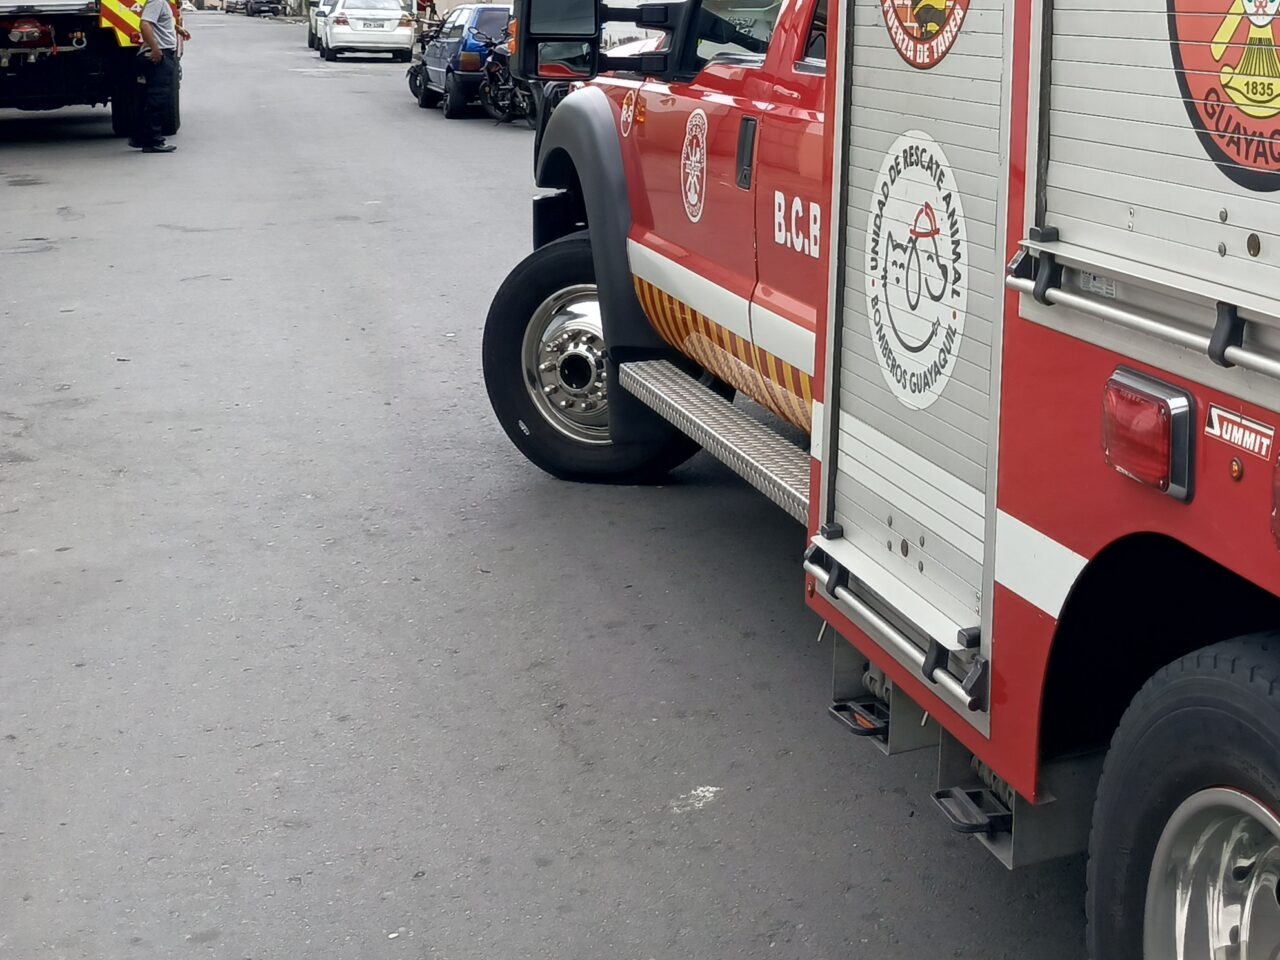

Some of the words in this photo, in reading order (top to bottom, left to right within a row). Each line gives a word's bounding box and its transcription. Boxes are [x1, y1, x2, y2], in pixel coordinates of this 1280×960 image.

[916, 43, 930, 63] DE
[931, 4, 964, 59] TAREA
[1244, 81, 1274, 97] 1835
[870, 181, 890, 271] UNIDAD
[888, 155, 903, 187] DE
[902, 145, 945, 191] RESCATE
[942, 192, 962, 298] ANIMAL
[871, 294, 908, 390] BOMBEROS
[909, 324, 958, 394] GUAYAQUIL
